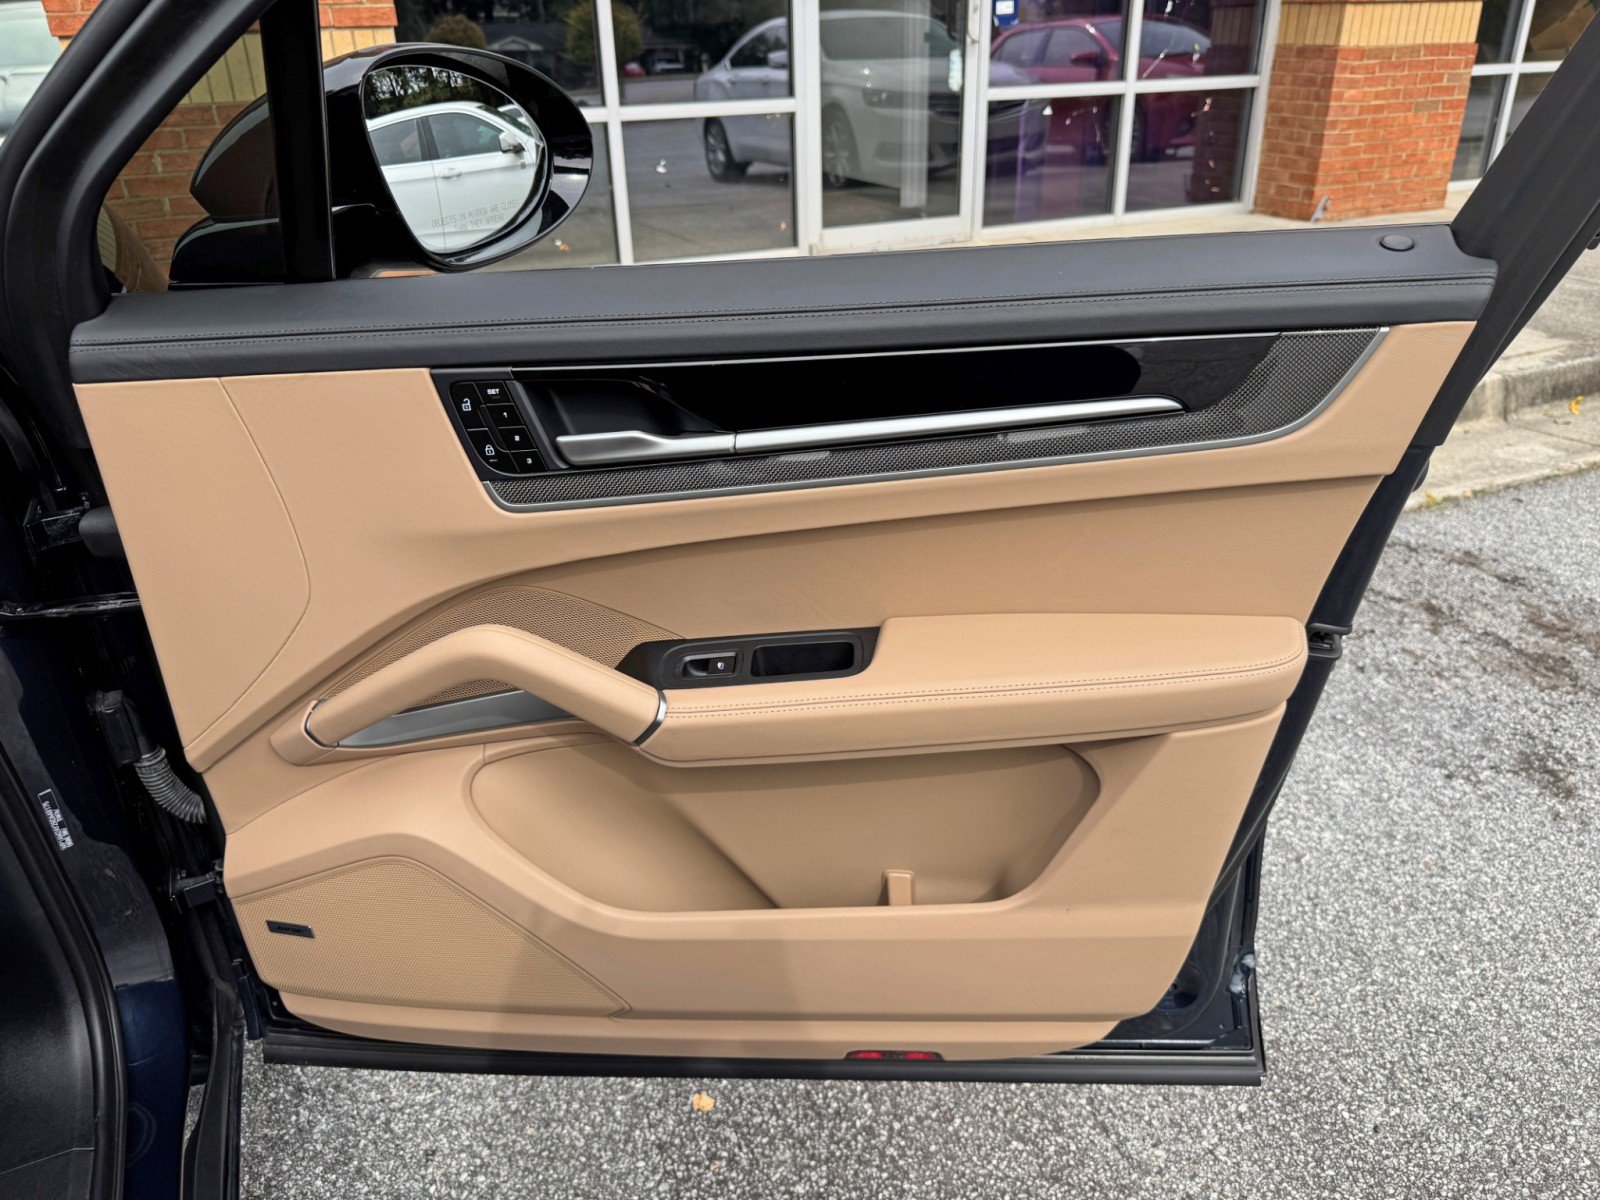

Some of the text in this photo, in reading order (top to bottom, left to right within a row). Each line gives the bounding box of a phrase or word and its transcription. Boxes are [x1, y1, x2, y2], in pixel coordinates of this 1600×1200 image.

[432, 214, 457, 228] OBJECTS
[467, 207, 488, 218] MIRROR
[490, 203, 500, 212] ARE
[469, 218, 483, 228] THEY
[485, 213, 505, 225] APPEAR
